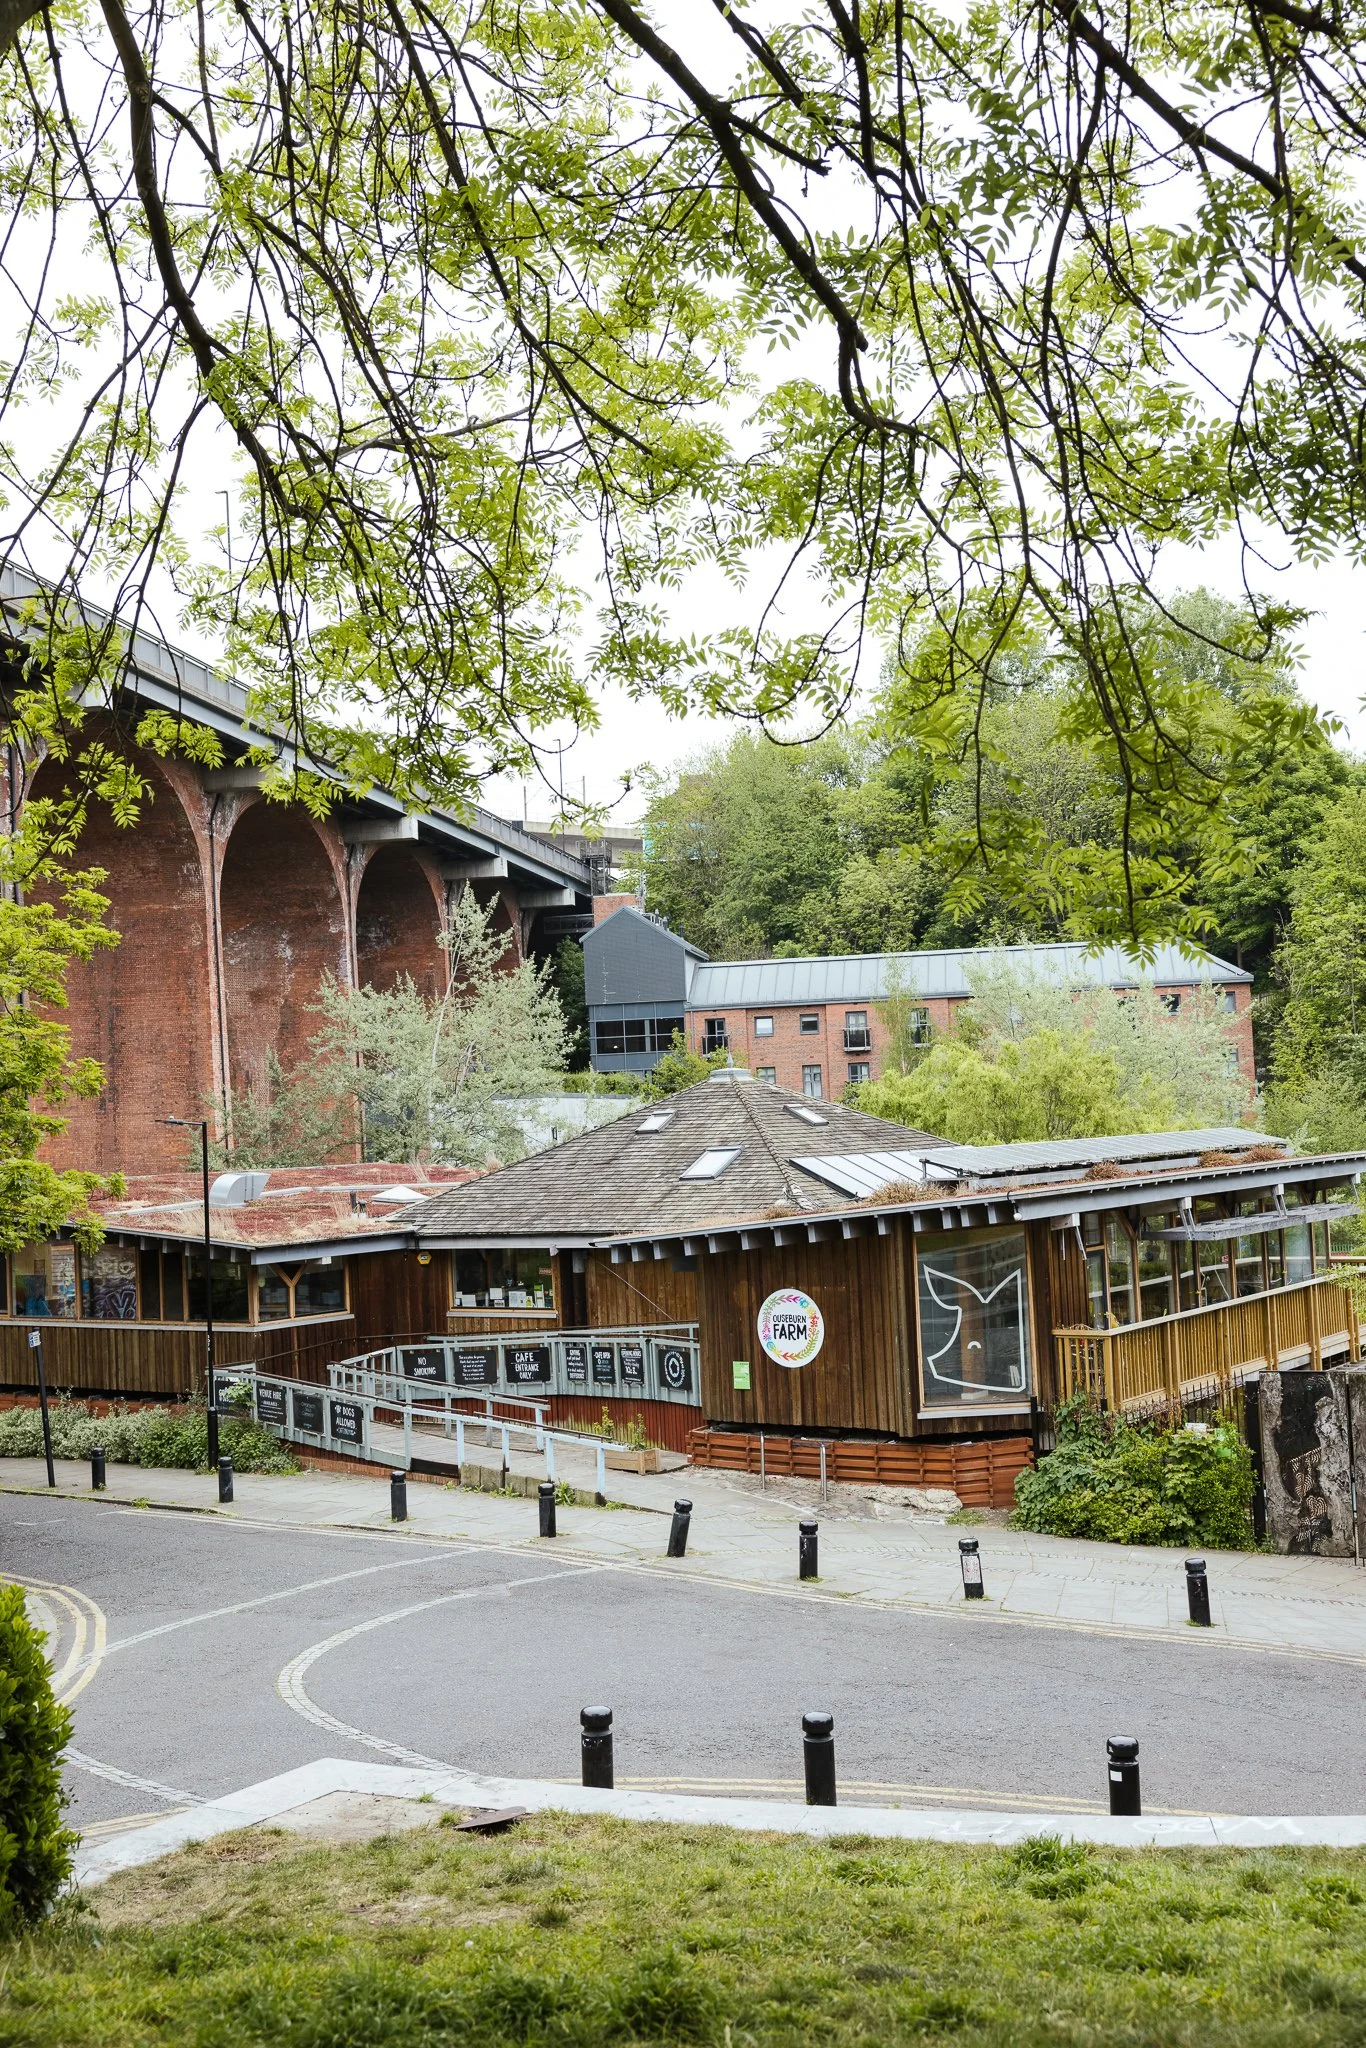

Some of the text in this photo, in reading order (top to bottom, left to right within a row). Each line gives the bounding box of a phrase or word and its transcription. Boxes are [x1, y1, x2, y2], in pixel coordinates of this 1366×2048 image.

[773, 1314, 806, 1323] OUSEBURN
[773, 1324, 807, 1340] FARM
[418, 1357, 426, 1365] NO
[515, 1352, 534, 1362] CAFE
[414, 1367, 436, 1376] SMOKING
[515, 1363, 540, 1371] ENTRANCE
[259, 1389, 281, 1400] VENUE HIRE
[343, 1407, 354, 1417] DOGS
